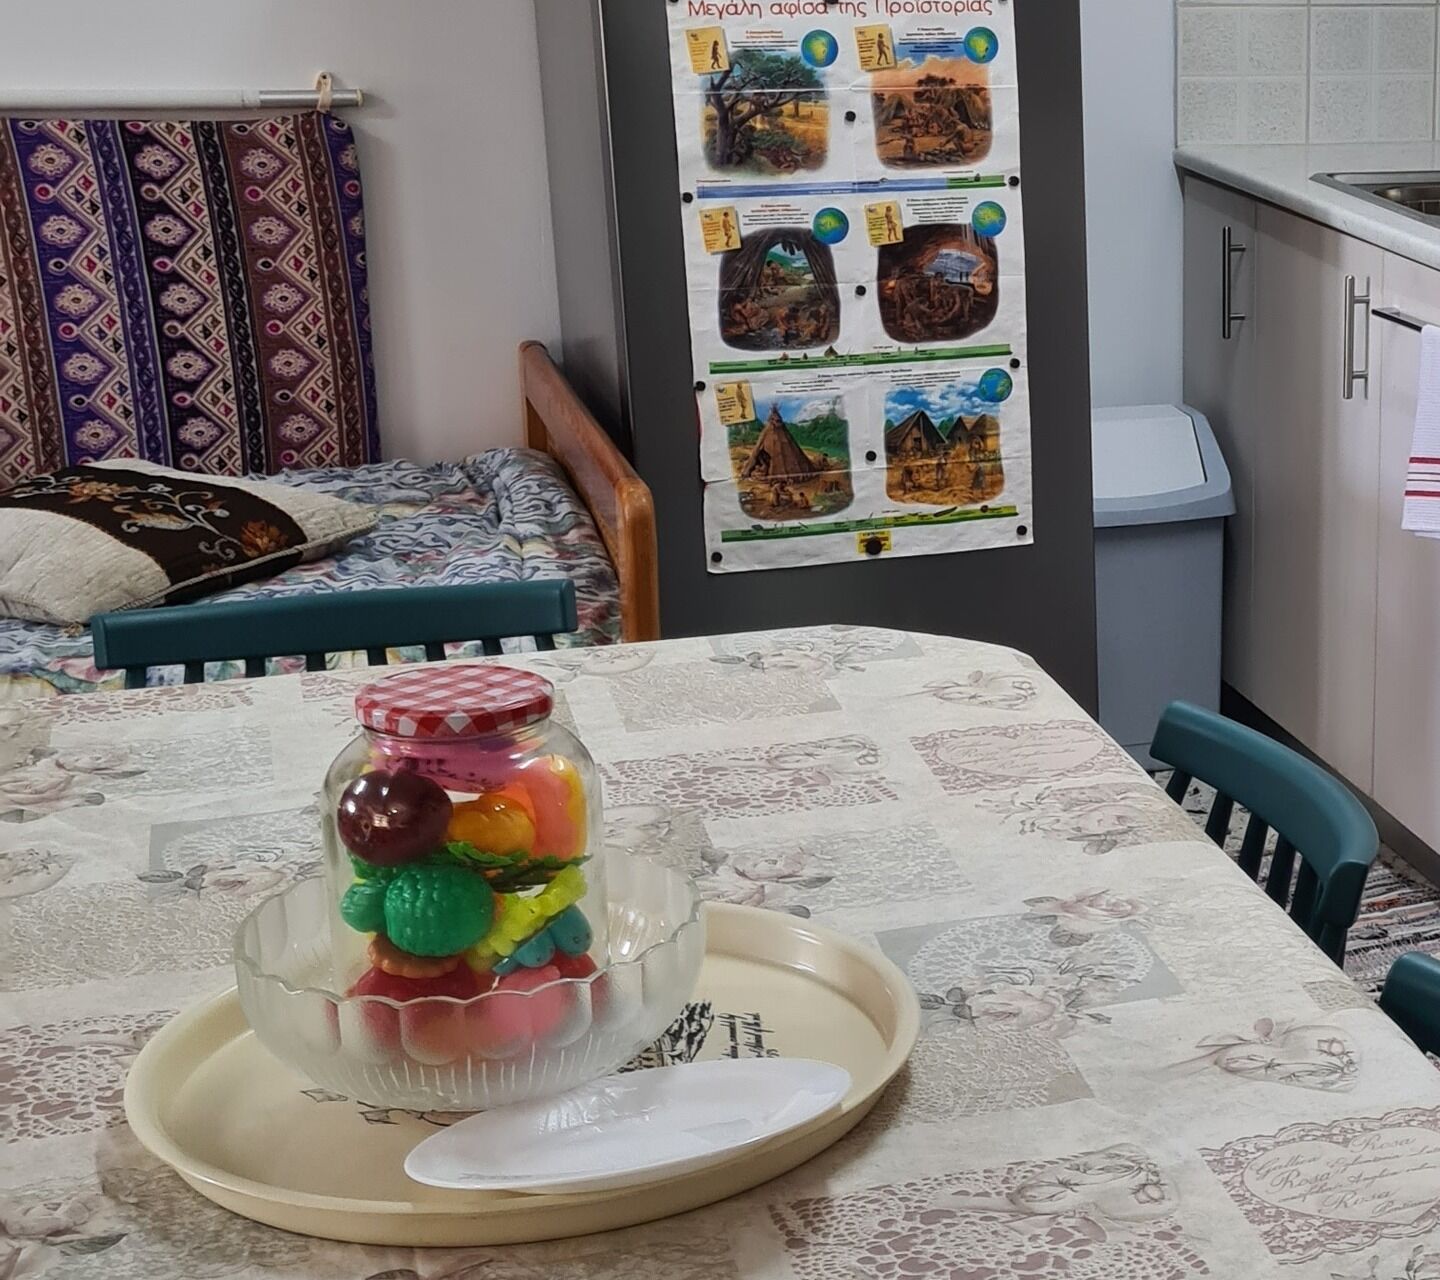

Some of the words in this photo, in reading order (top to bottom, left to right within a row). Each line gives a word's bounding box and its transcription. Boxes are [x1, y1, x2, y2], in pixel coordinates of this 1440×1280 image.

[688, 0, 763, 19] Μεγάλη
[769, 0, 830, 19] αφίσα
[838, 0, 867, 19] της
[1350, 1133, 1417, 1153] Rosa
